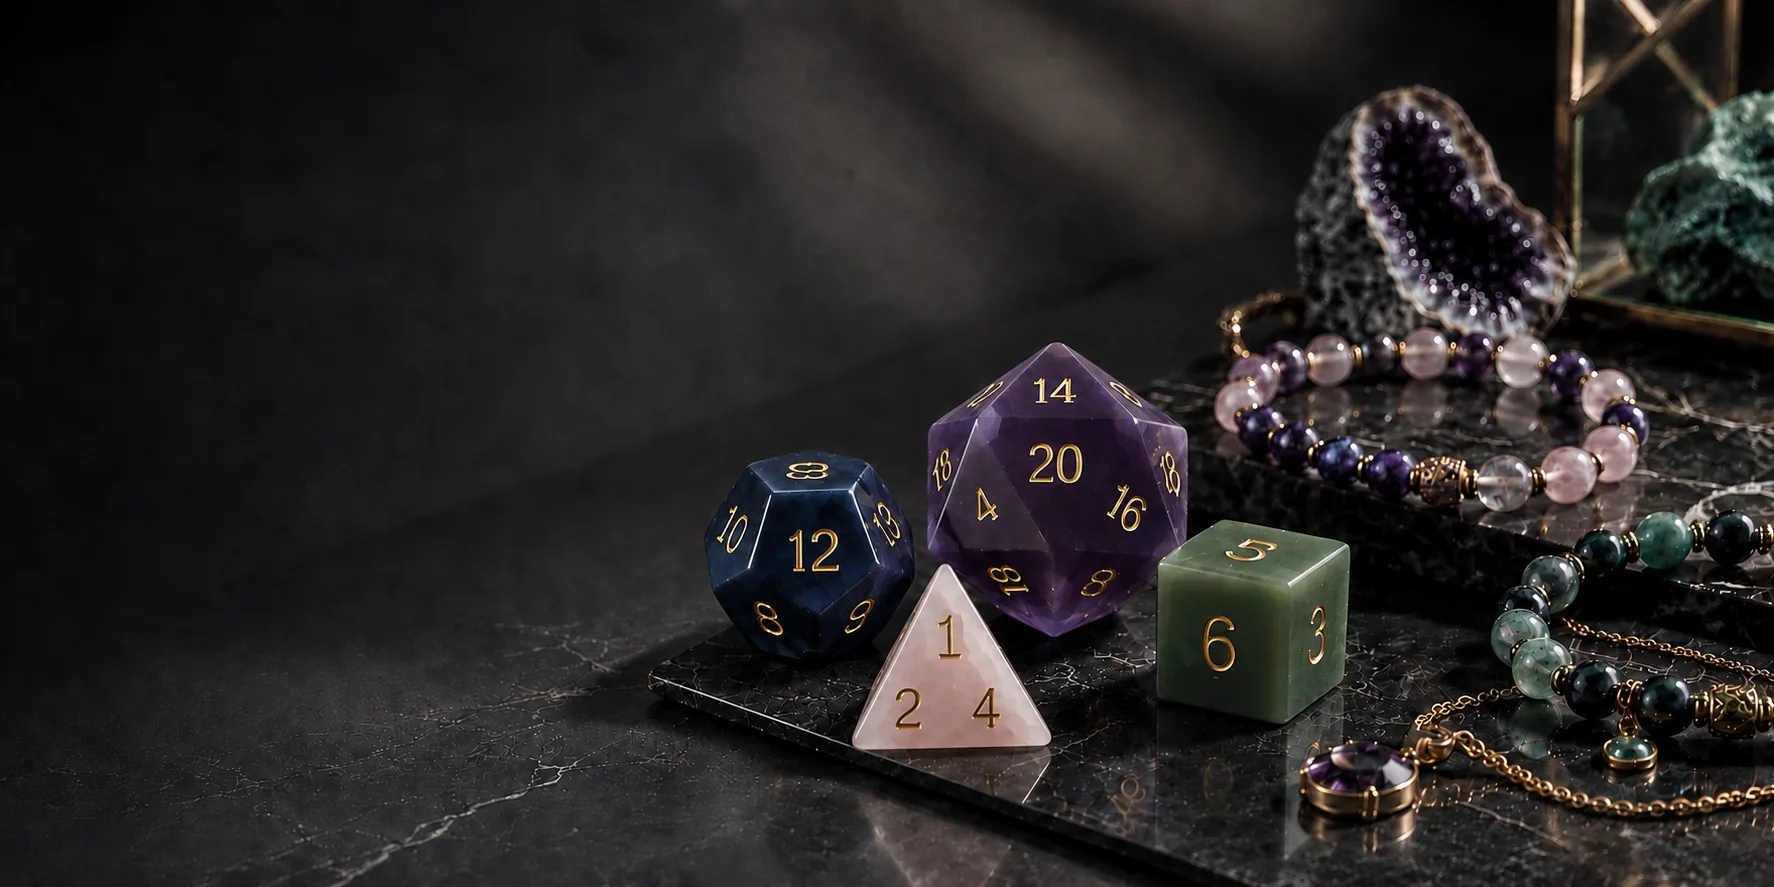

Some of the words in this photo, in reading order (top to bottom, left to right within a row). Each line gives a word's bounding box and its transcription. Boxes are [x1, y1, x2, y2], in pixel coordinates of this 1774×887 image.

[1033, 377, 1077, 404] 14
[932, 448, 952, 492] 18
[1028, 443, 1084, 484] 20
[1159, 450, 1181, 498] 18
[872, 501, 901, 548] 13
[975, 487, 999, 522] 4
[1106, 484, 1147, 532] 16
[716, 505, 748, 554] 10
[789, 529, 840, 573] 12
[1225, 538, 1278, 562] 5
[754, 601, 784, 636] 8
[937, 614, 962, 660] 1
[1308, 605, 1326, 665] 3
[1202, 615, 1236, 672] 6
[895, 688, 923, 730] 2
[972, 688, 1001, 729] 4
